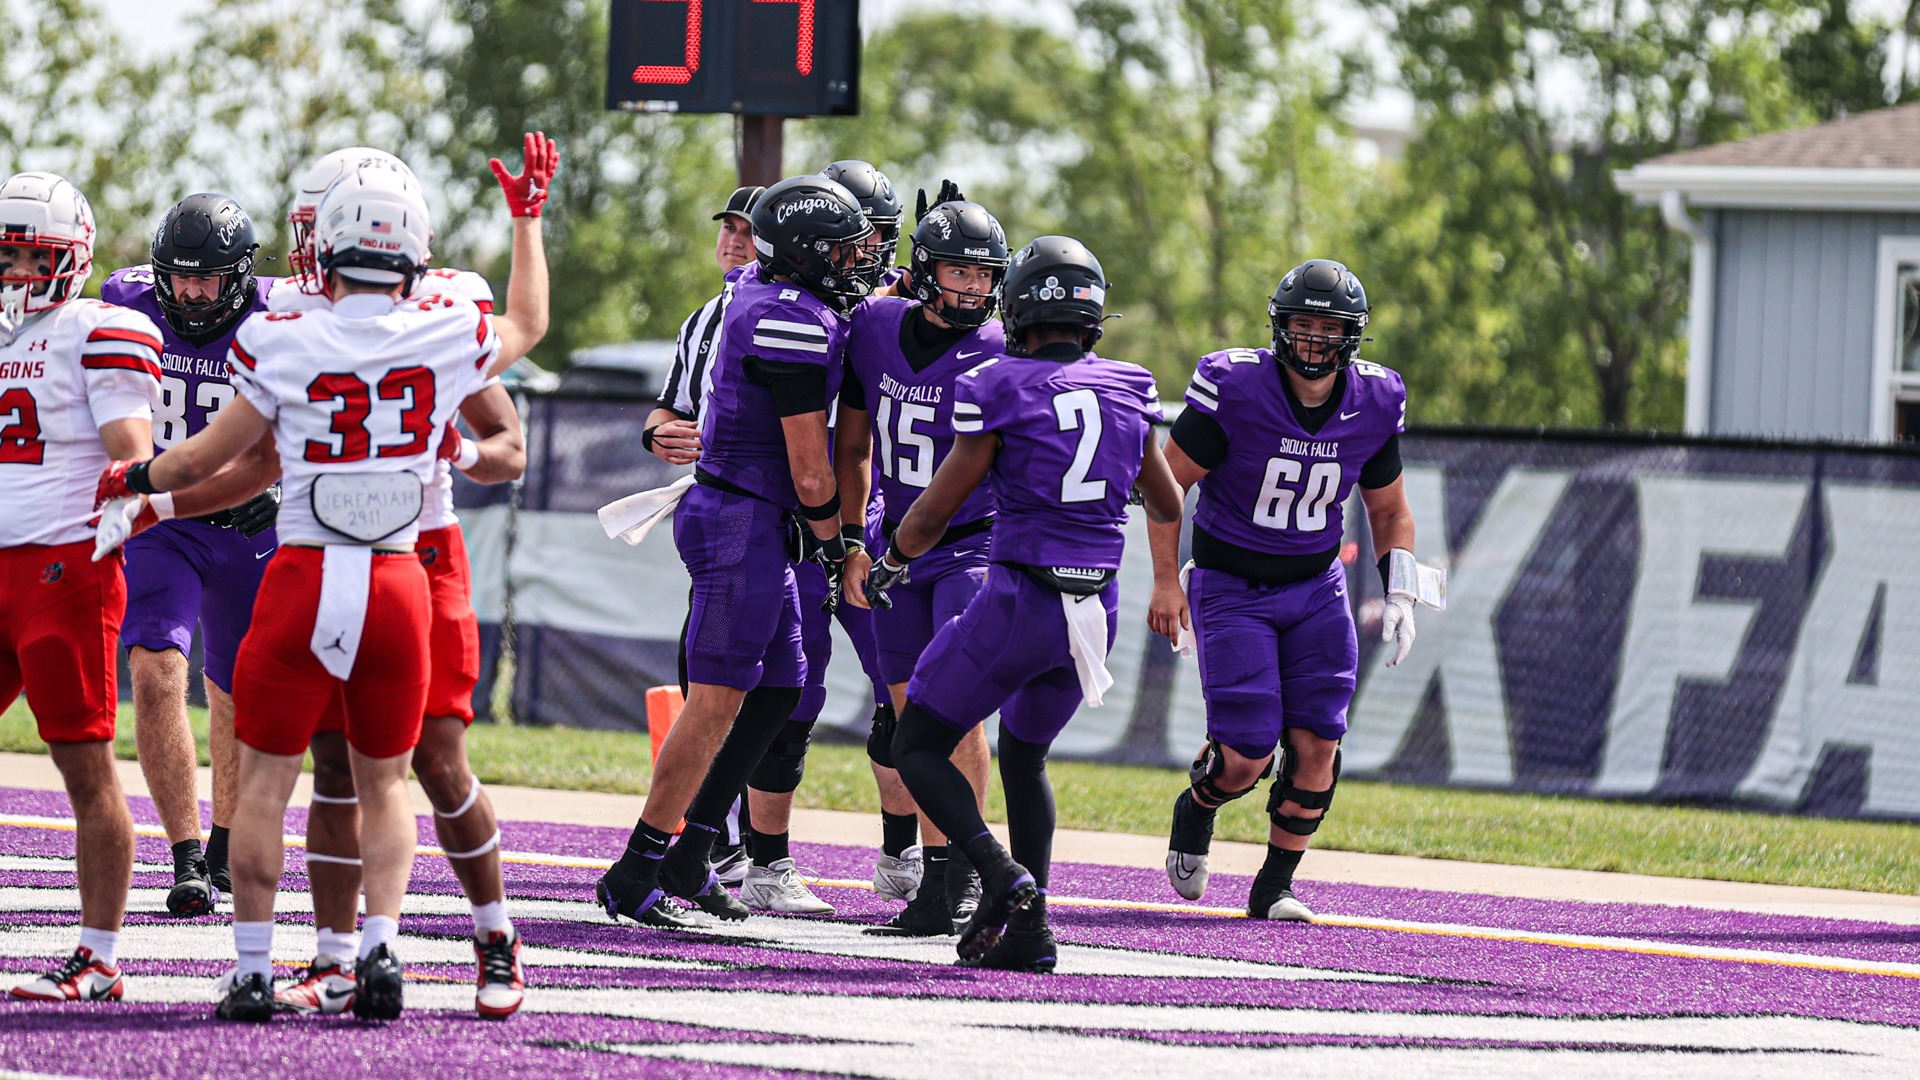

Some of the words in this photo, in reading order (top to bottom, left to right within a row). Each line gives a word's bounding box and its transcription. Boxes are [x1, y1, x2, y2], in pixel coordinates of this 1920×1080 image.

[777, 198, 842, 224] Cougars
[359, 238, 378, 248] FIND
[379, 241, 384, 249] A
[386, 241, 402, 251] WAY
[964, 248, 990, 257] Riddell
[173, 258, 200, 267] Riddell
[1304, 299, 1331, 308] Riddell
[699, 340, 710, 354] S
[0, 361, 45, 379] GONS
[162, 353, 193, 374] SIOUX
[195, 358, 230, 379] FALLS
[879, 372, 909, 400] SIOUX
[907, 385, 943, 403] FALLS
[304, 365, 436, 463] 33
[876, 395, 936, 488] 15
[1052, 388, 1107, 503] 2
[1280, 437, 1310, 456] SIOUX
[1310, 442, 1339, 458] FALLS
[322, 491, 415, 508] JEREMIAH
[1252, 457, 1341, 531] 60
